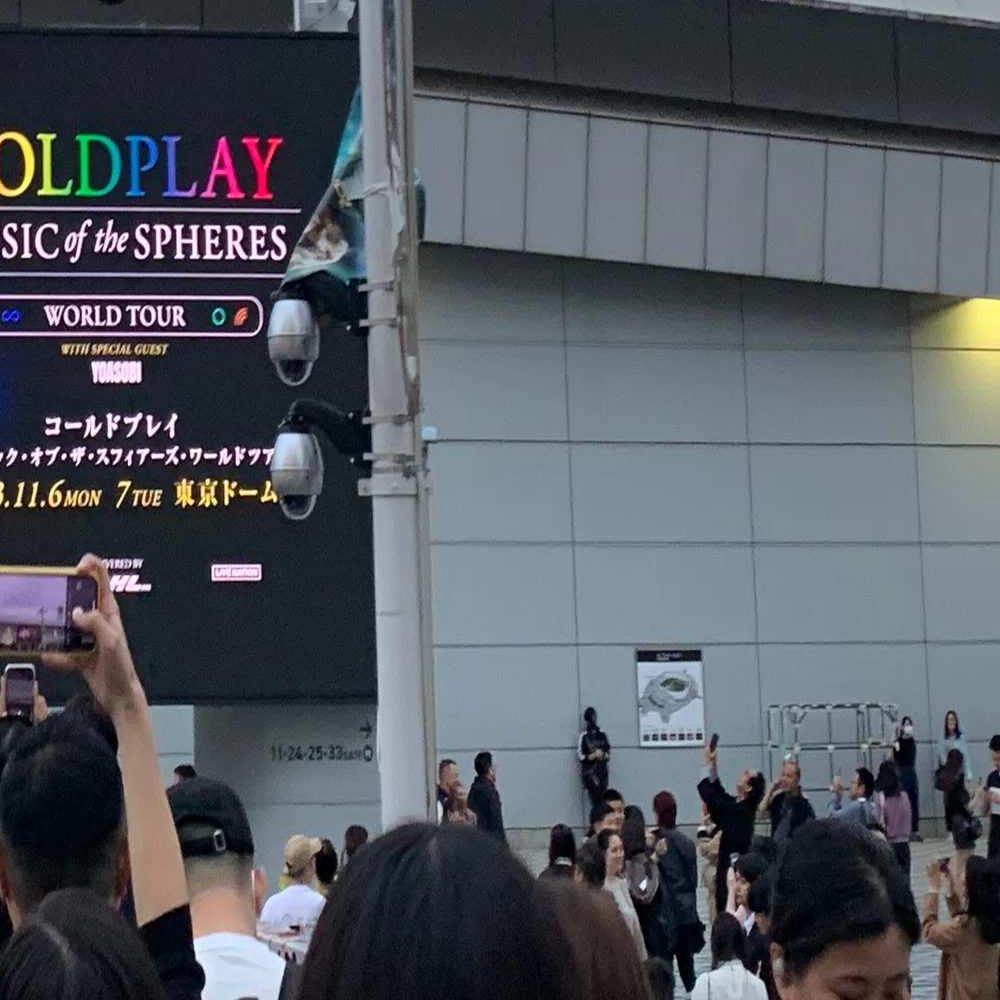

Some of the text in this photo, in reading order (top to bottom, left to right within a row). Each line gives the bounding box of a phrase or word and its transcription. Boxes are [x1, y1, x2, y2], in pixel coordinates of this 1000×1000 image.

[64, 219, 93, 263] of
[94, 219, 130, 254] the
[133, 224, 287, 261] SPHERES
[43, 304, 187, 328] WORLD TOUR
[61, 342, 170, 356] WITH SPECIAL GUEST
[91, 360, 142, 384] YOASOBI
[44, 412, 179, 440] コールドプレイ
[173, 477, 280, 509] 東京ドーム
[110, 574, 146, 592] HL
